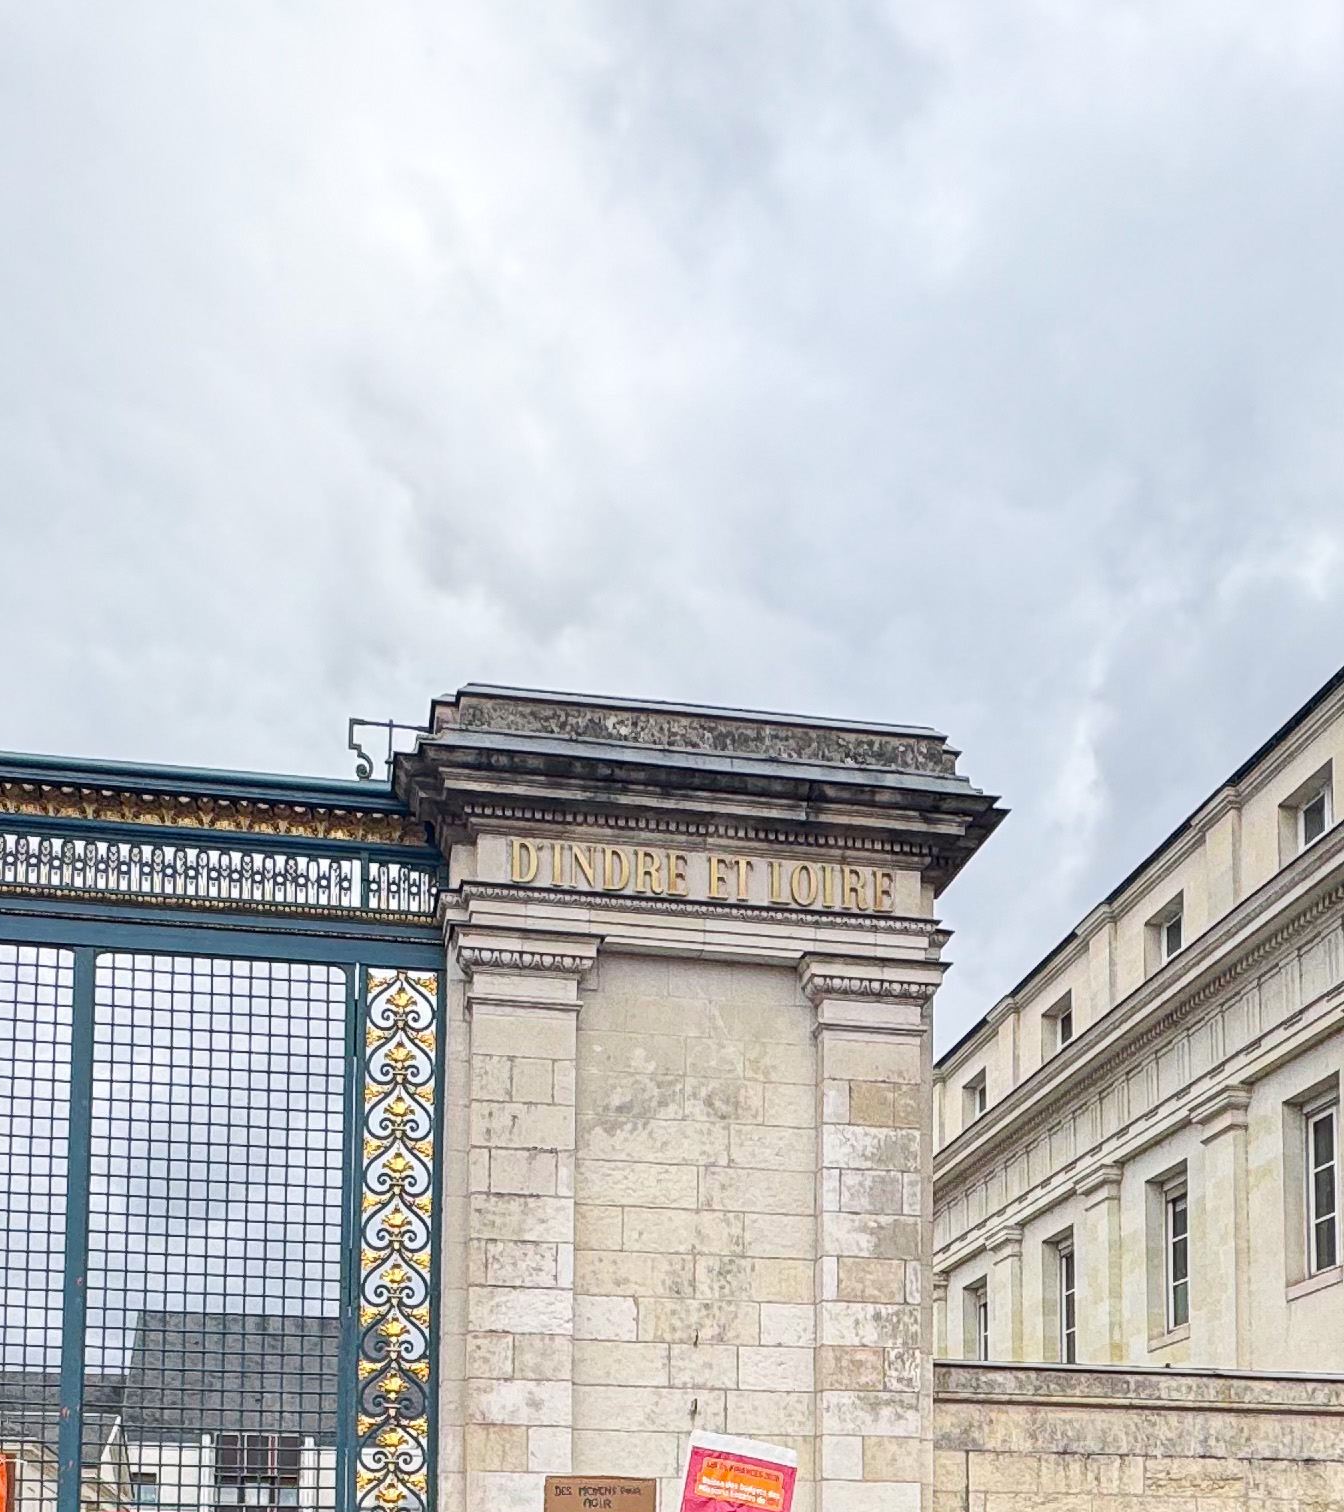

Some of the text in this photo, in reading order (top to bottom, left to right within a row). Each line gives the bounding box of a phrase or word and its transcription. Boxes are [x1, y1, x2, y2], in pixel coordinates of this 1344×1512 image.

[511, 837, 894, 913] D'INDRE ET LOIRE
[583, 1498, 612, 1509] AGIR
